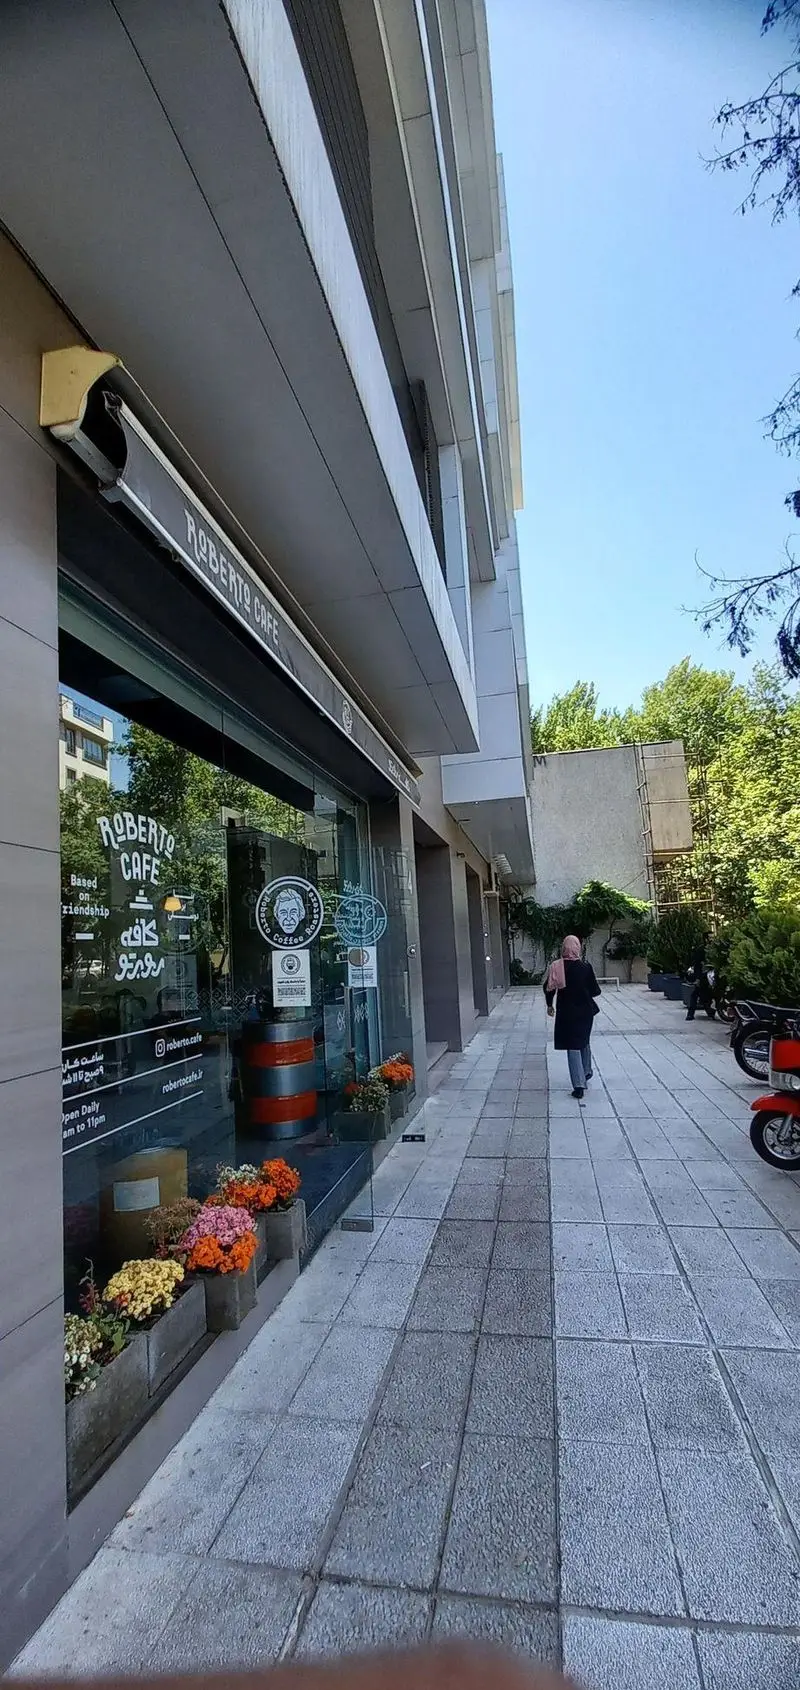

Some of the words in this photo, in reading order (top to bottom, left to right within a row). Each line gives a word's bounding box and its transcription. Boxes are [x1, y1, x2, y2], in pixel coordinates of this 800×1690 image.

[184, 508, 251, 613] ROBERTO
[254, 596, 279, 646] CAFE
[96, 811, 175, 860] ROBERTO
[121, 851, 161, 886] CAFE
[70, 874, 97, 889] Based
[78, 892, 90, 901] on
[60, 902, 110, 919] riendship
[260, 894, 271, 934] Roberto
[273, 933, 304, 945] Coffee
[120, 917, 159, 947] کافه
[114, 952, 165, 981] روبرتو
[166, 1032, 203, 1051] roberto.cafe
[162, 1069, 203, 1094] robertocafe.ir
[81, 1100, 100, 1116] Daily
[76, 1123, 86, 1133] to
[86, 1115, 106, 1128] 11pm
